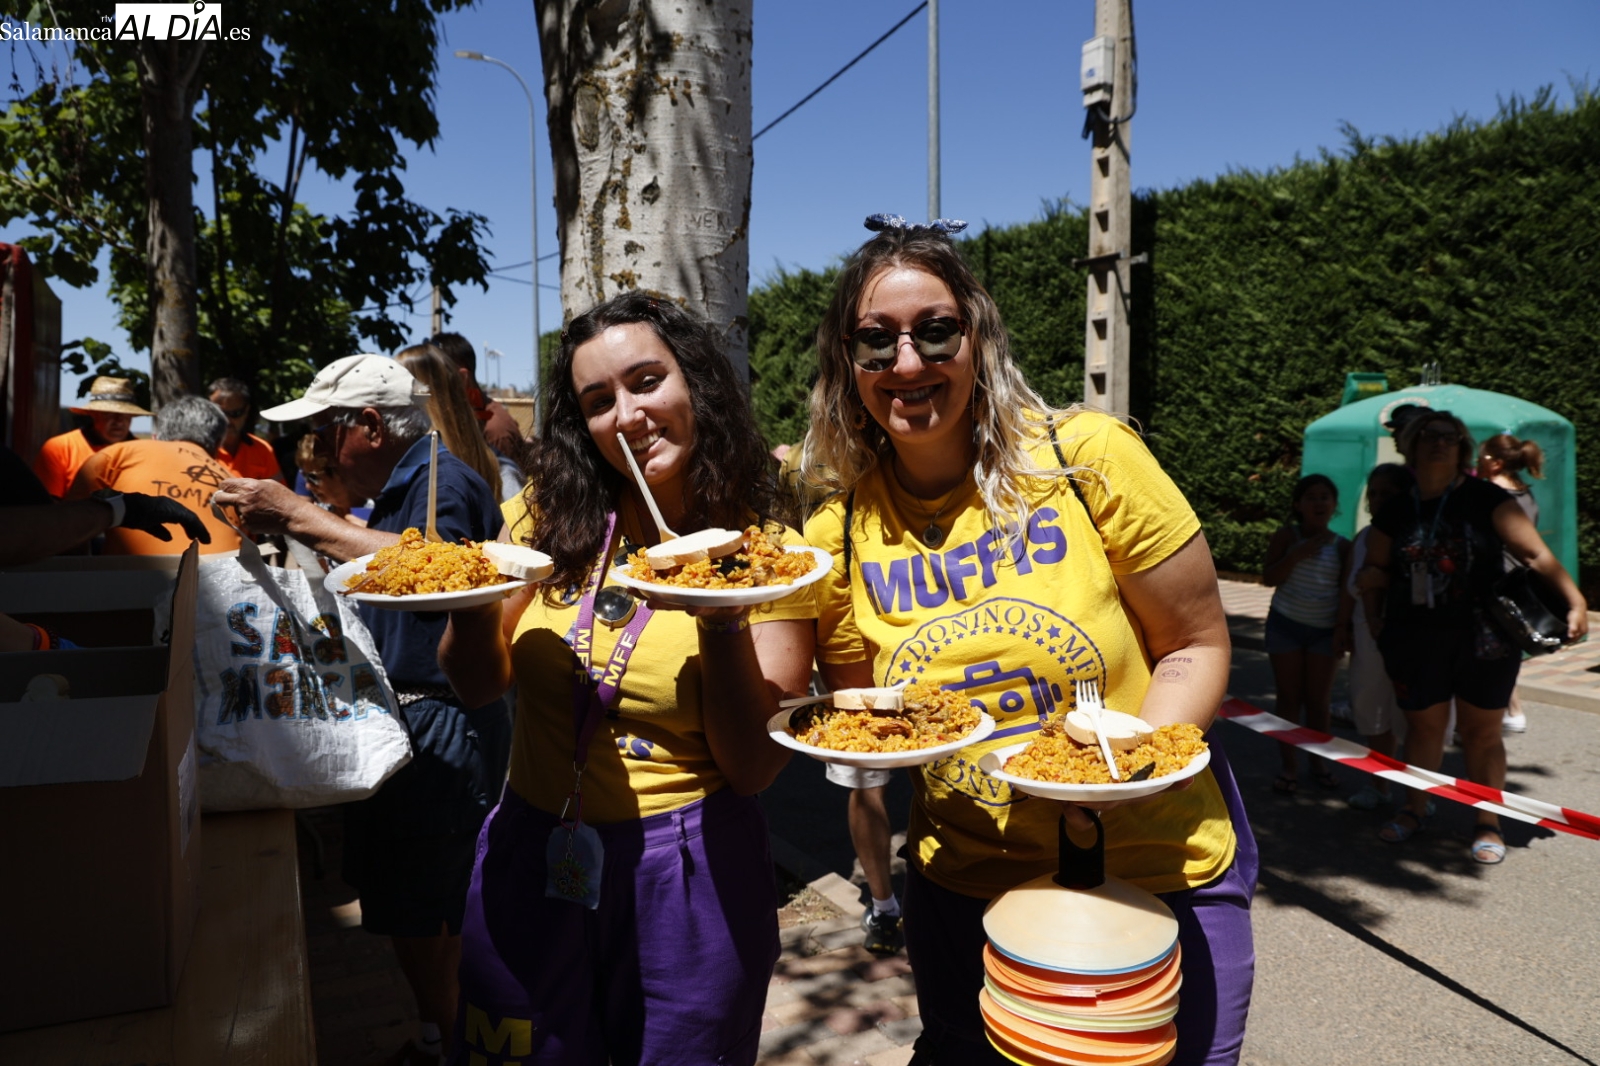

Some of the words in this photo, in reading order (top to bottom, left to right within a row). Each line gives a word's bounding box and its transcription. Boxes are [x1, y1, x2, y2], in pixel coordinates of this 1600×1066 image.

[861, 507, 1068, 616] MUFFIS
[575, 628, 592, 685] MFF
[603, 632, 635, 687] MFF
[906, 603, 1046, 662] DONINOS
[1160, 656, 1193, 665] MUFFIS
